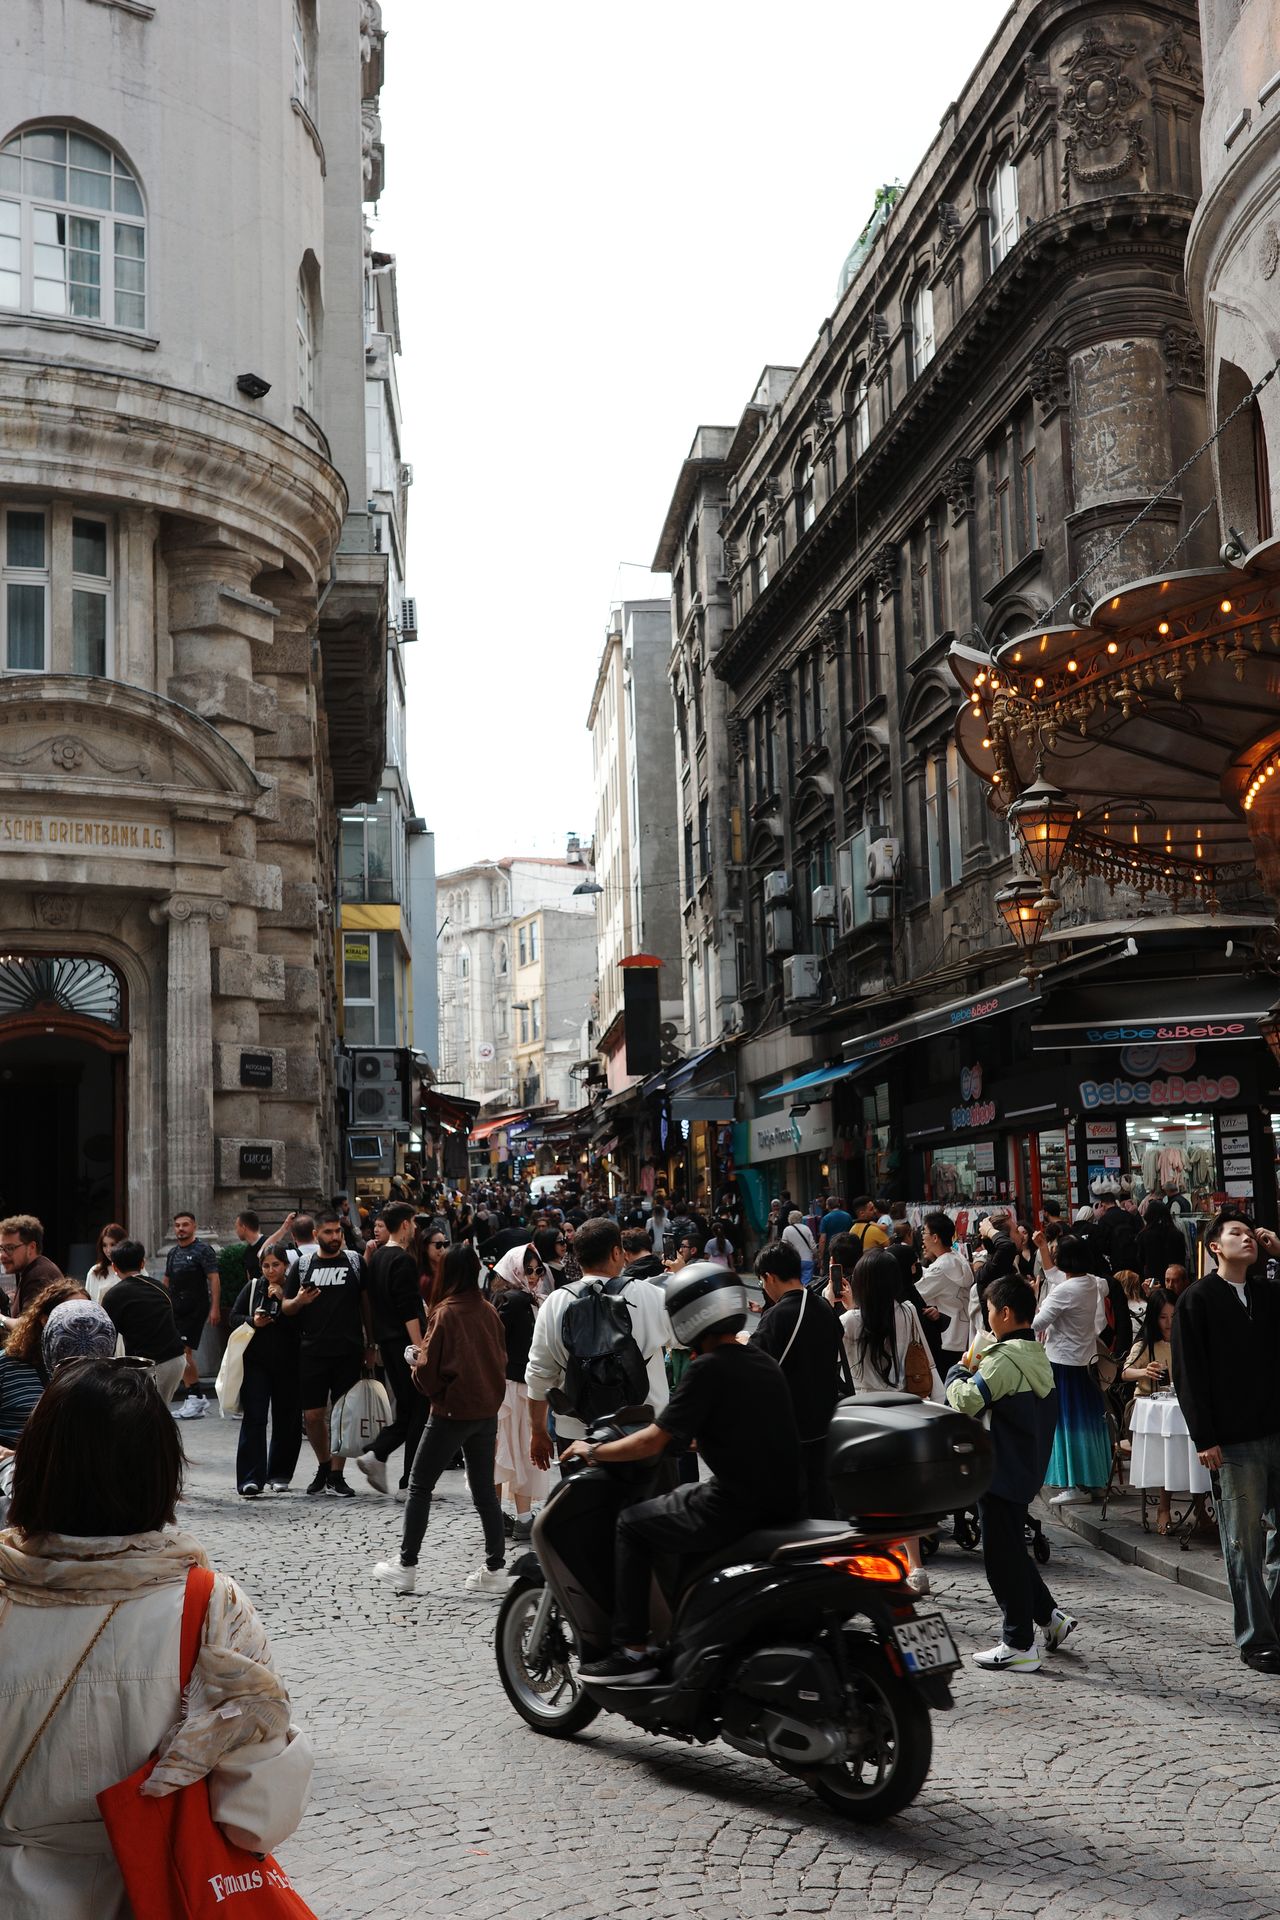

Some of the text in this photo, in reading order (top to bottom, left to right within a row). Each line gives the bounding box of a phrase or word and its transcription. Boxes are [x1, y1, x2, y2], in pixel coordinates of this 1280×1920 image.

[50, 822, 139, 847] ORIENTBANK
[143, 828, 165, 849] A.G.
[1088, 1023, 1245, 1042] Bebe&Bebe
[1081, 1076, 1239, 1109] Bebe&Bebe
[310, 1267, 349, 1286] NIKE
[897, 1626, 919, 1648] 34
